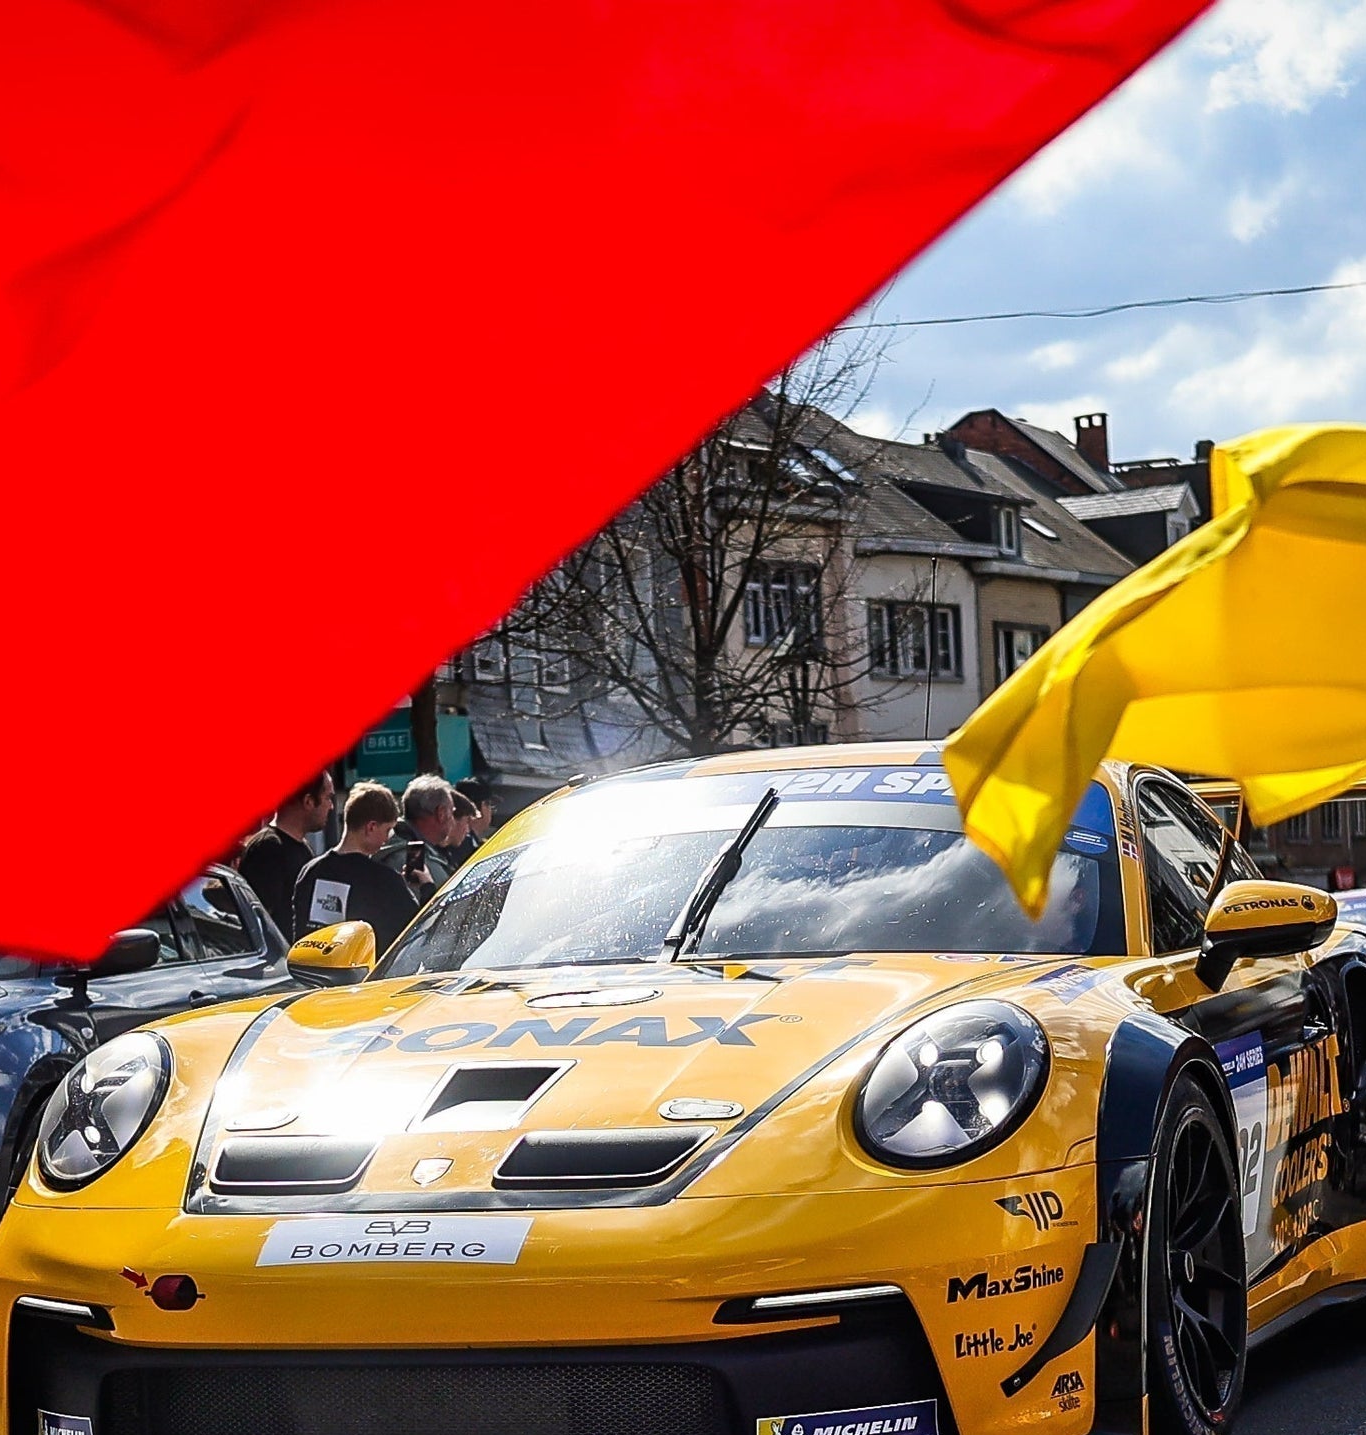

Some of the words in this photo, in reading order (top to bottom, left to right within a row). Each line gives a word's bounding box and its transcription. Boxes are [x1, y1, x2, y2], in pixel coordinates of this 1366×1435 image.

[368, 734, 407, 748] BASE
[763, 771, 871, 795] 12H
[1223, 898, 1299, 915] PETRONAS
[1271, 1132, 1328, 1209] COOLERS
[289, 1241, 487, 1260] BOMBERG
[946, 1264, 1065, 1304] MaxShine
[954, 1328, 1004, 1359] Little
[1051, 1371, 1085, 1396] ARSA
